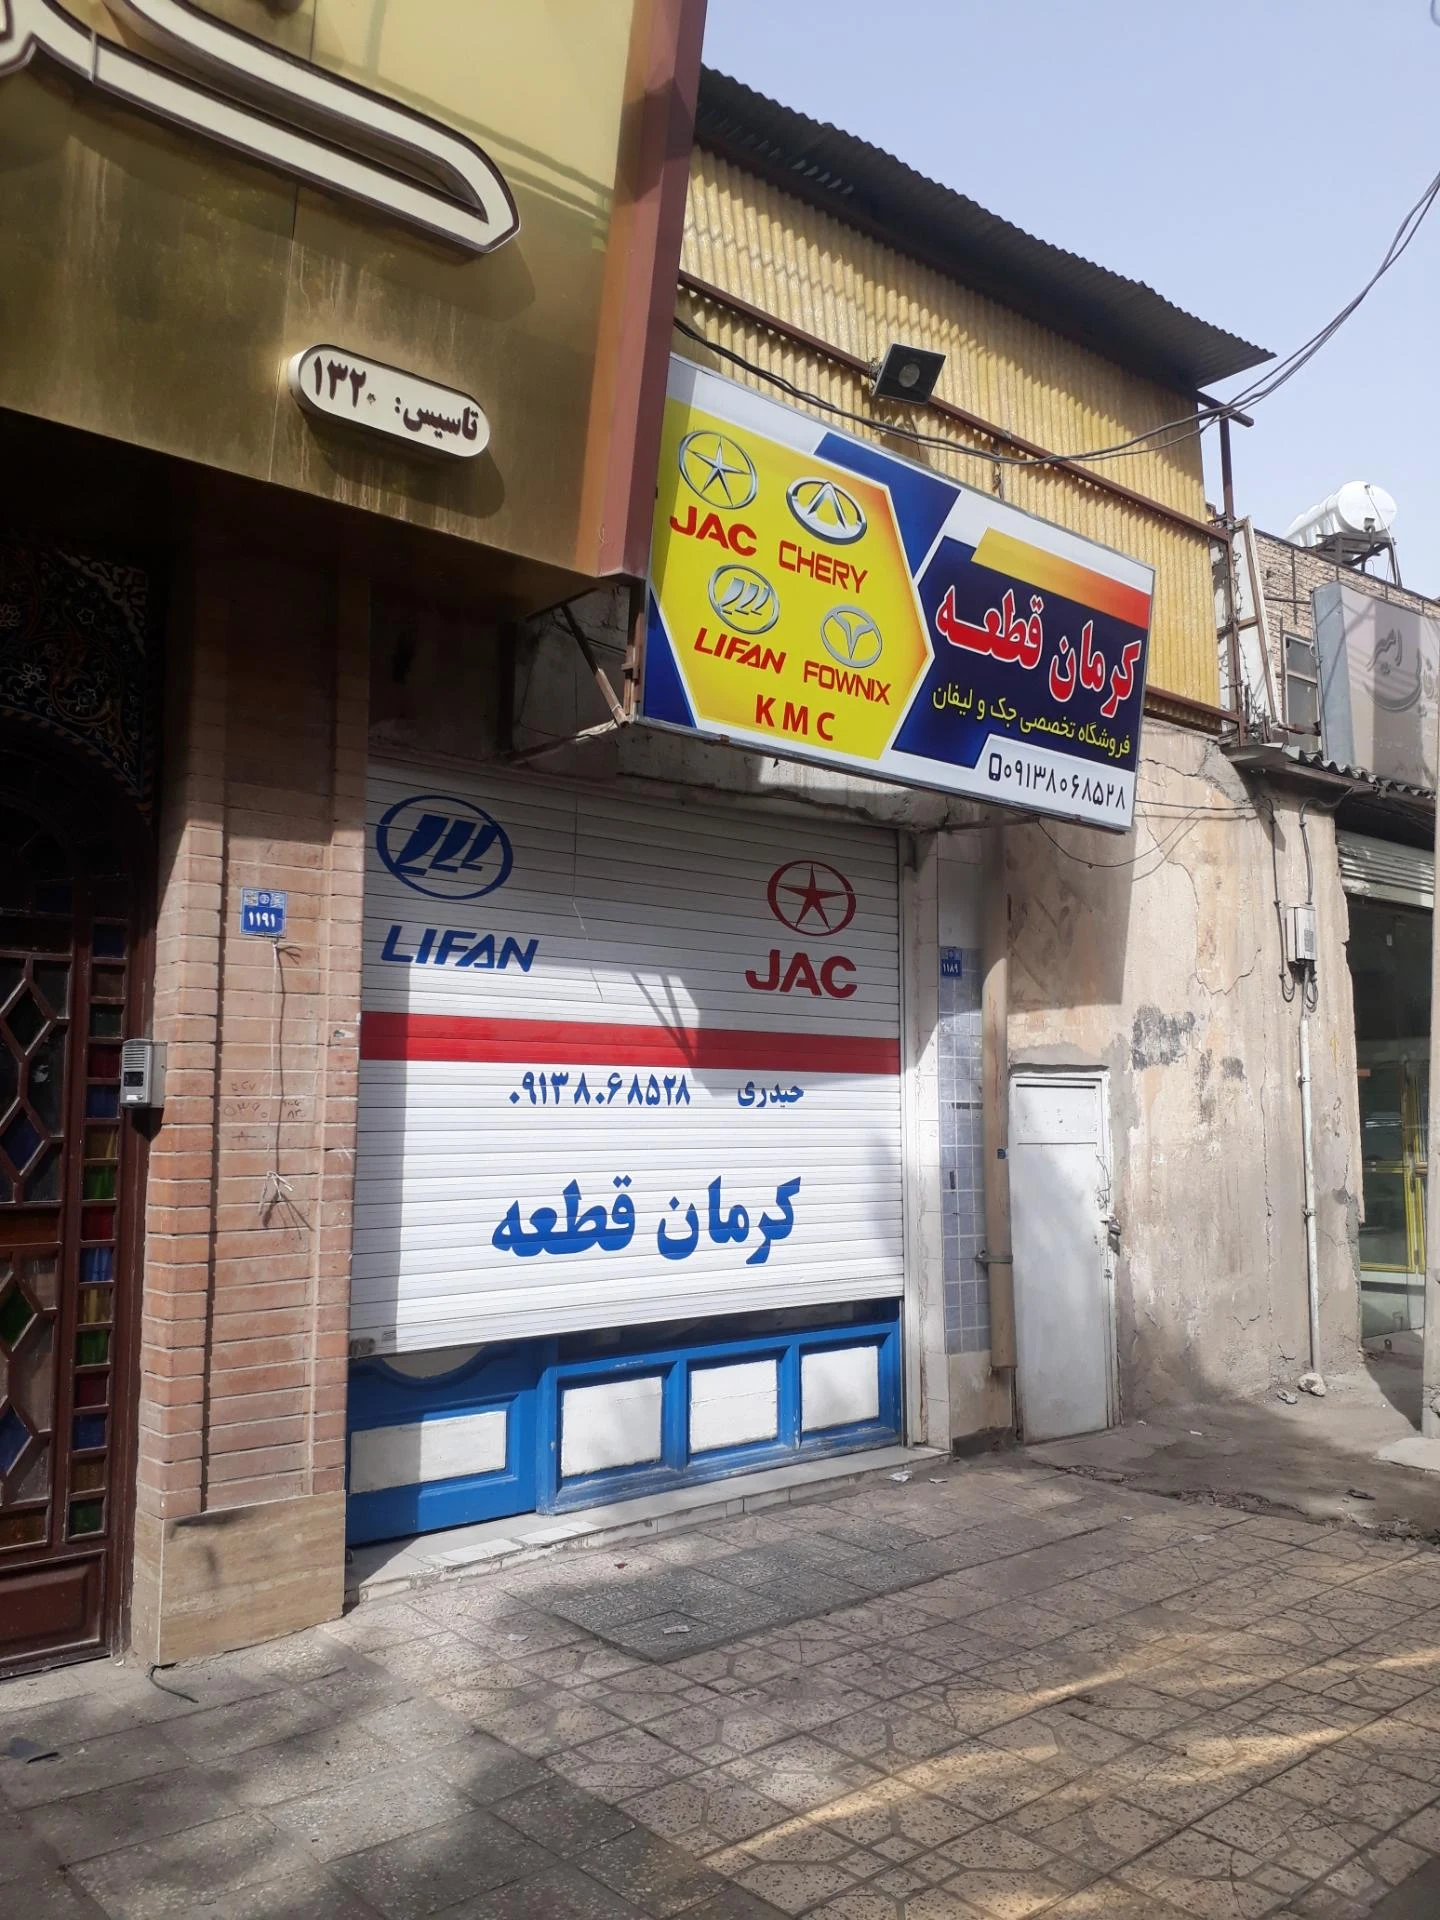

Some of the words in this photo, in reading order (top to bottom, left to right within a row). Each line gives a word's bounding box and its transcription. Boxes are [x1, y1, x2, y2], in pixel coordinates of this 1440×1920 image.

[394, 396, 479, 441] تاسیس:
[669, 505, 757, 557] JAC
[778, 540, 868, 594] CHERY
[693, 627, 787, 674] LIFAN
[935, 585, 1044, 670] قطعه
[803, 659, 892, 705] FOWNIX
[1049, 619, 1142, 718] کرمان
[932, 683, 973, 715] لیفان
[976, 700, 986, 719] و
[990, 698, 1017, 728] جک
[1020, 715, 1076, 738] تخصصی
[1078, 724, 1131, 758] فروشگاه
[1003, 759, 1126, 810] ۰۹۱۳۸۰۶۸۵۲۸
[248, 911, 276, 928] ۱۱۹۱
[380, 925, 539, 972] LIFAN
[745, 948, 857, 998] JAC
[737, 1080, 805, 1108] حیدری
[491, 1174, 636, 1258] قطعه
[657, 1175, 802, 1265] کرمان
